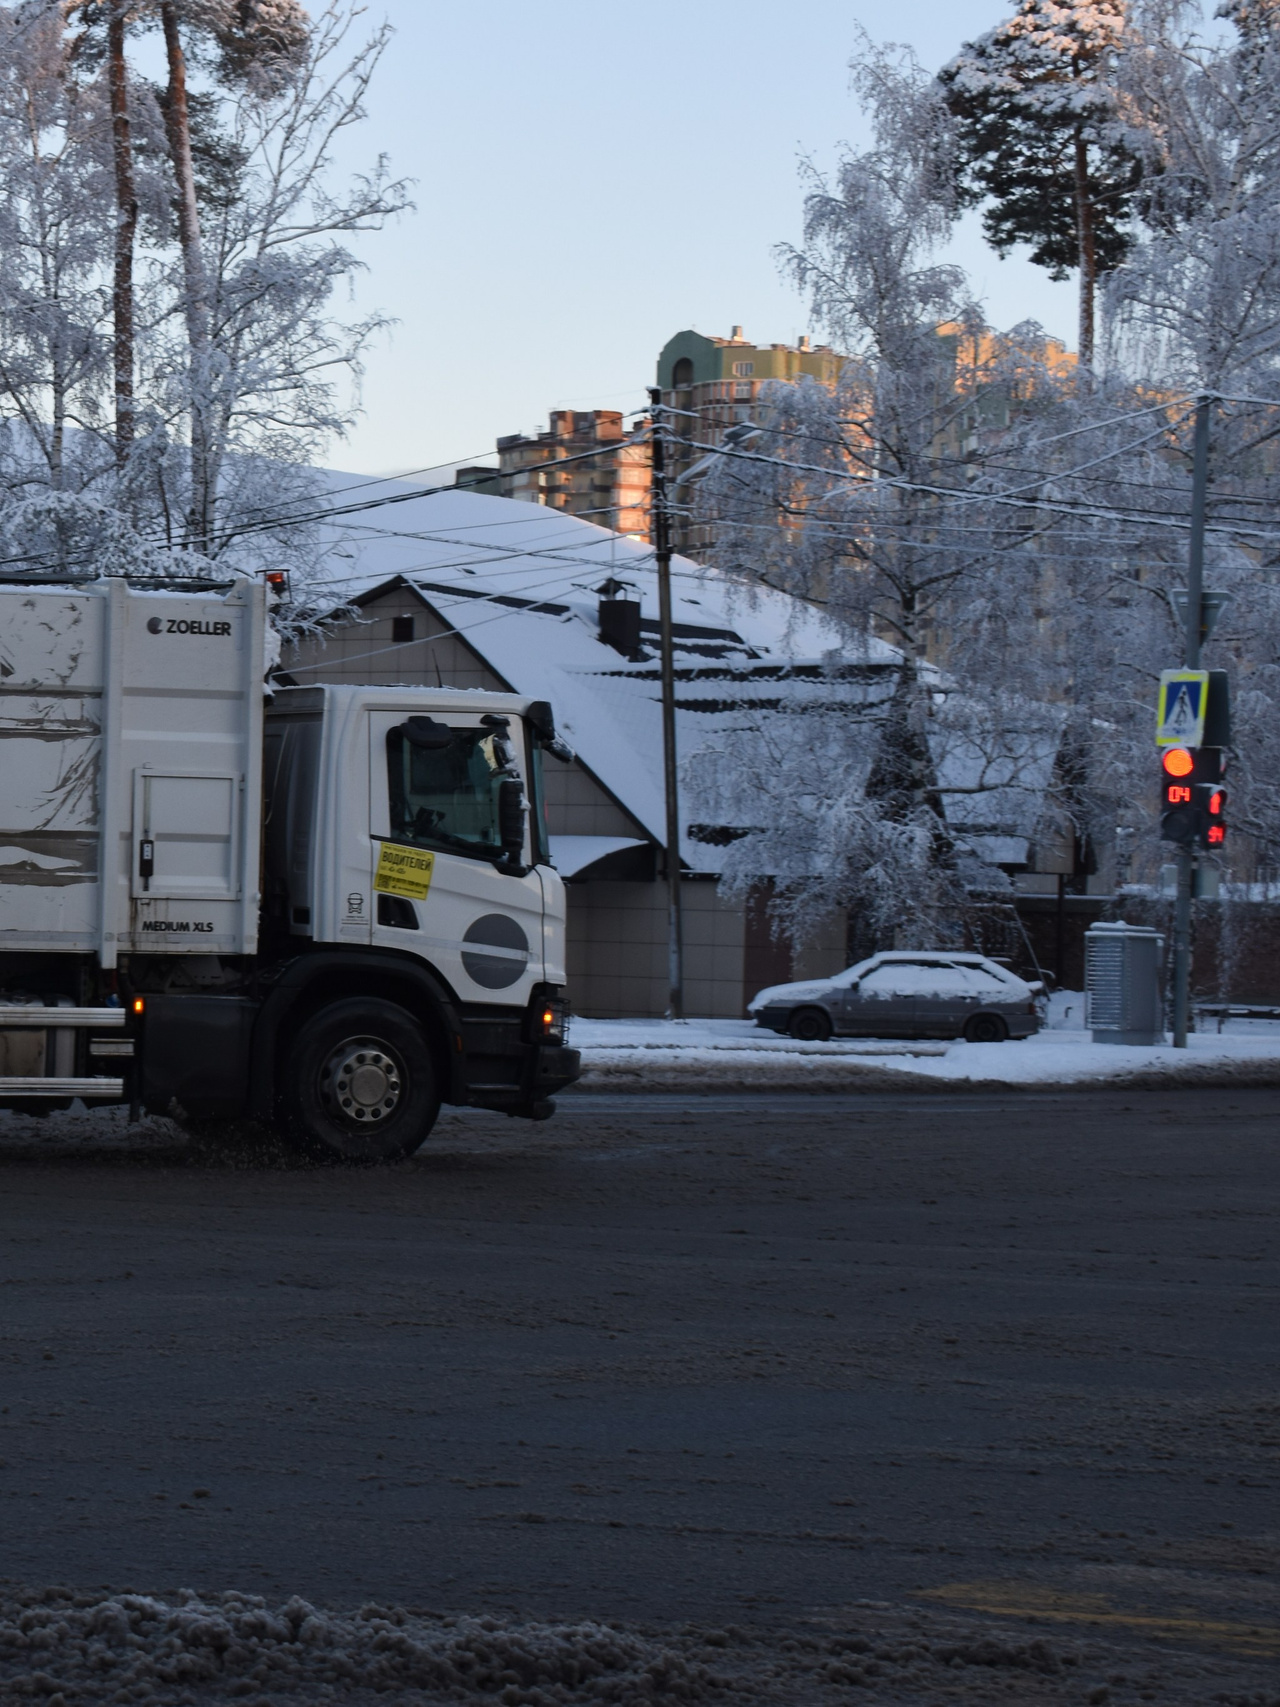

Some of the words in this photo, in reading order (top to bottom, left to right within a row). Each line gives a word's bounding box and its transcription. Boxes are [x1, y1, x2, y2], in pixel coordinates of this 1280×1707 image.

[166, 619, 231, 636] ZOELLER
[1169, 786, 1191, 803] 04
[382, 851, 432, 871] ВОДИТЕЛЕЙ
[142, 921, 190, 932] MEDIUM
[193, 922, 213, 932] XLS
